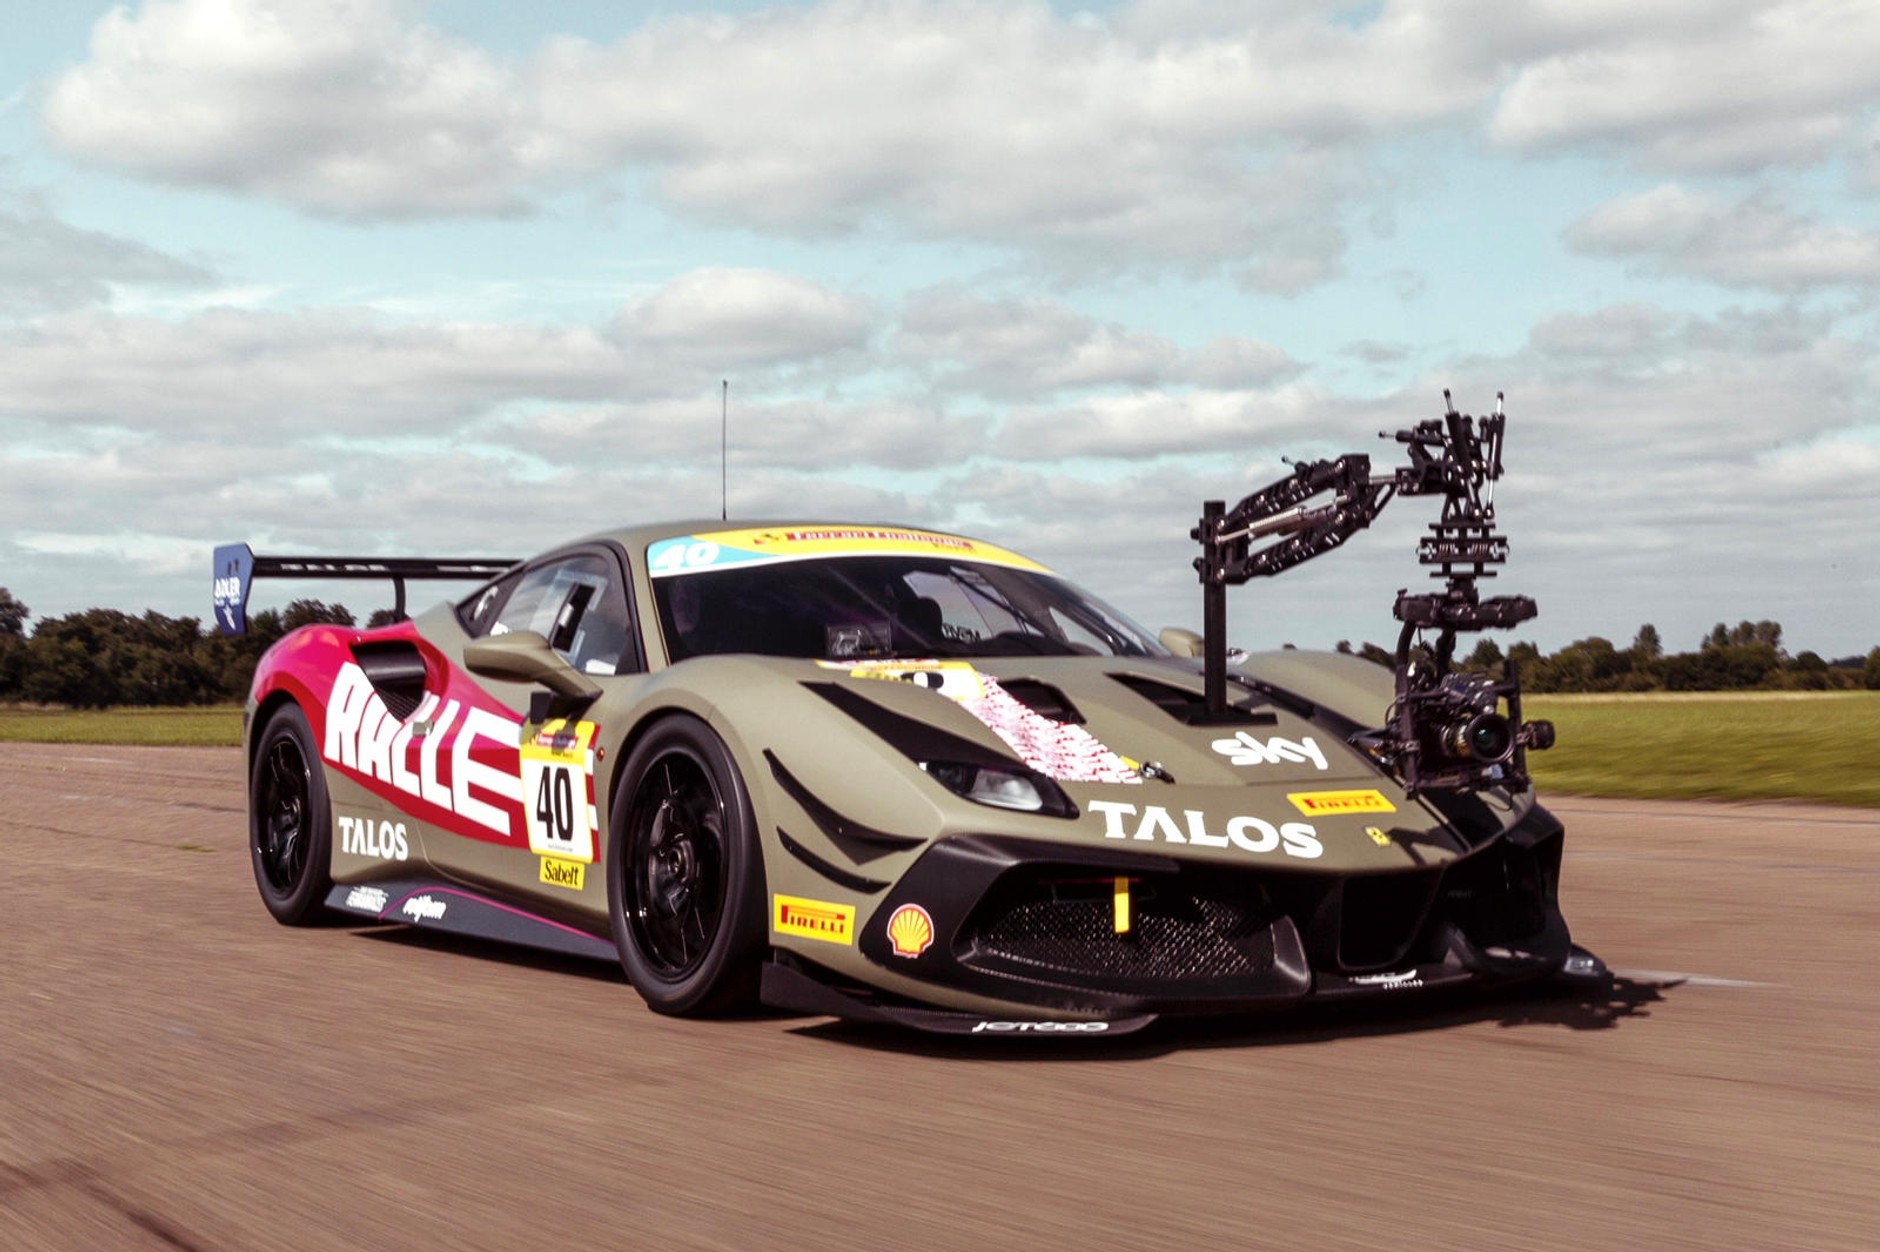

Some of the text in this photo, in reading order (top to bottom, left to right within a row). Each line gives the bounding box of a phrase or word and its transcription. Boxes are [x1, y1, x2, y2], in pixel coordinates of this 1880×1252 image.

[652, 541, 720, 570] 40
[536, 766, 574, 842] 40
[1303, 795, 1382, 810] PIRELLI
[338, 816, 410, 861] TALOS
[1087, 800, 1324, 860] TALOS
[544, 860, 580, 887] Sabelt
[780, 904, 846, 935] PIRELLI
